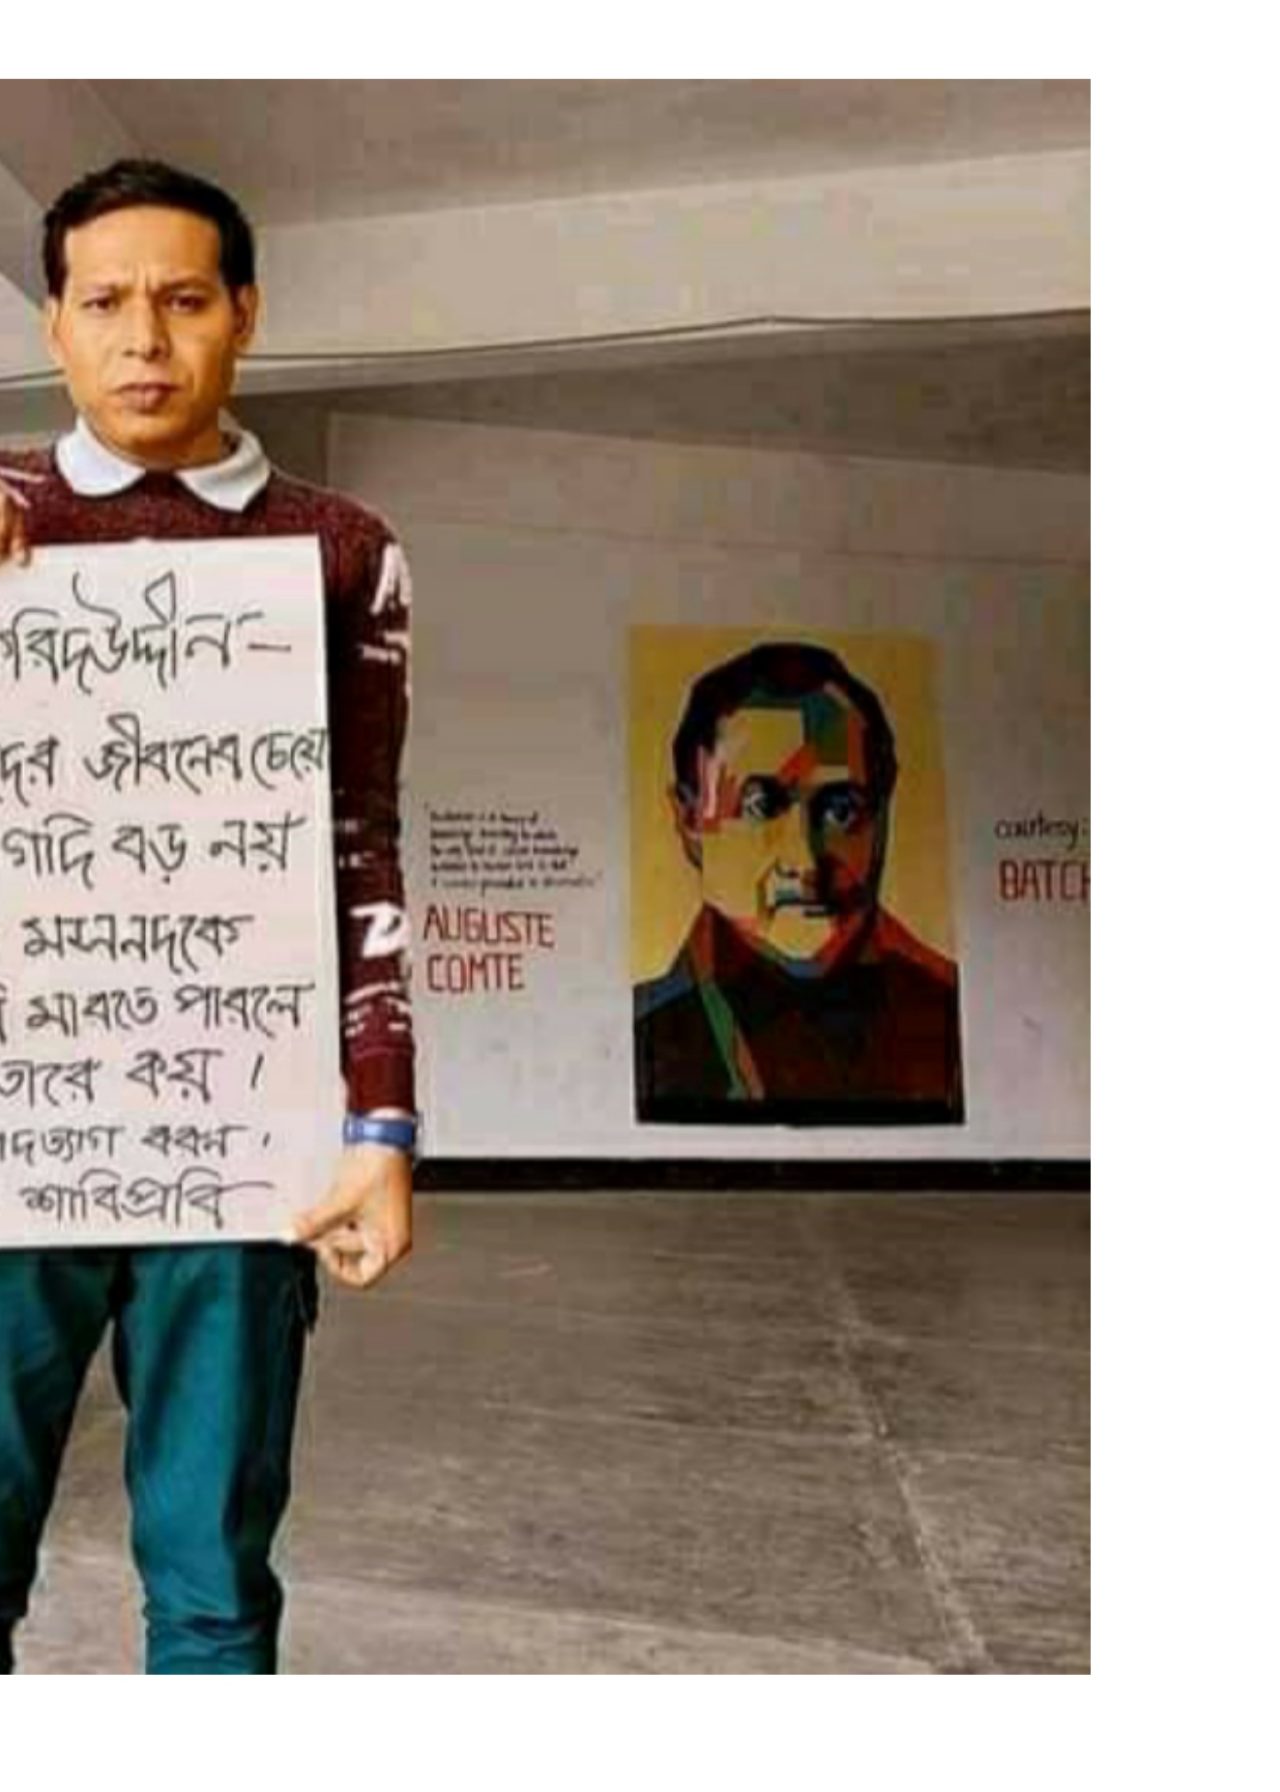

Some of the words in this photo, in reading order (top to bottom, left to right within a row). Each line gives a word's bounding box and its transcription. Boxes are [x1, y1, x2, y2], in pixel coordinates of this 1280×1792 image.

[111, 823, 188, 885] বড়
[422, 904, 554, 948] AUGUSTE
[426, 952, 526, 994] COMTE
